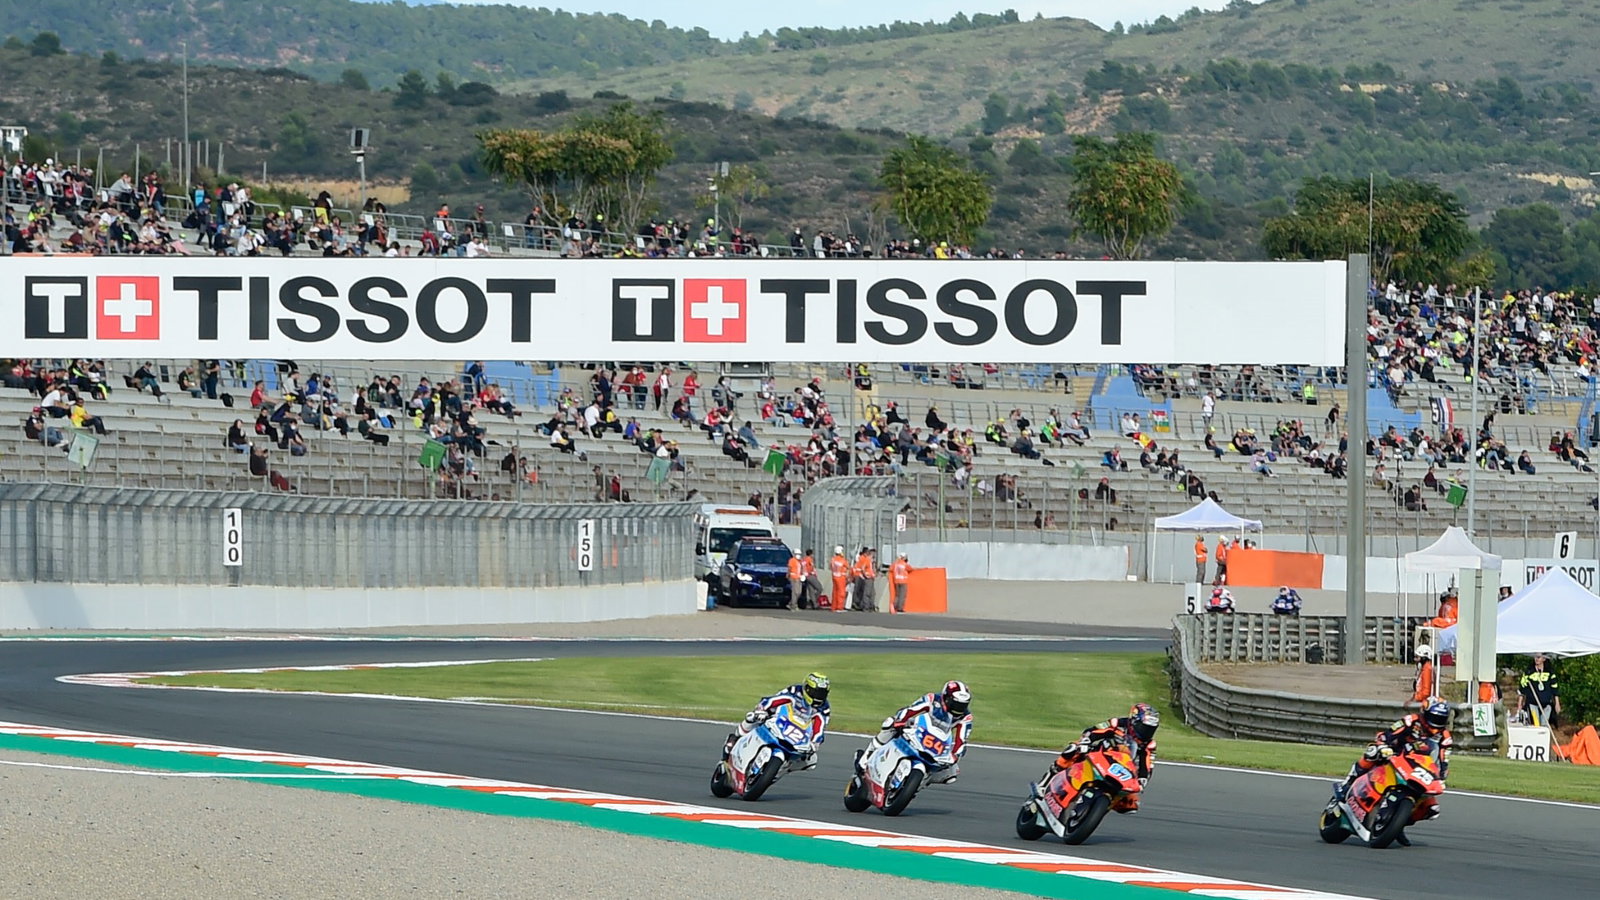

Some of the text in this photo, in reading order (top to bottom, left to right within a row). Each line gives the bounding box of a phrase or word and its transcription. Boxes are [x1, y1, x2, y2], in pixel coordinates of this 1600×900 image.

[173, 276, 556, 343] TISSOT
[760, 278, 1147, 346] TISSOT
[228, 512, 239, 562] 100
[582, 523, 591, 567] 150
[1560, 534, 1569, 559] 6
[1187, 596, 1196, 614] 5
[783, 724, 805, 743] 12
[922, 734, 944, 755] 64
[1508, 744, 1546, 760] TOR
[1410, 766, 1435, 785] 25
